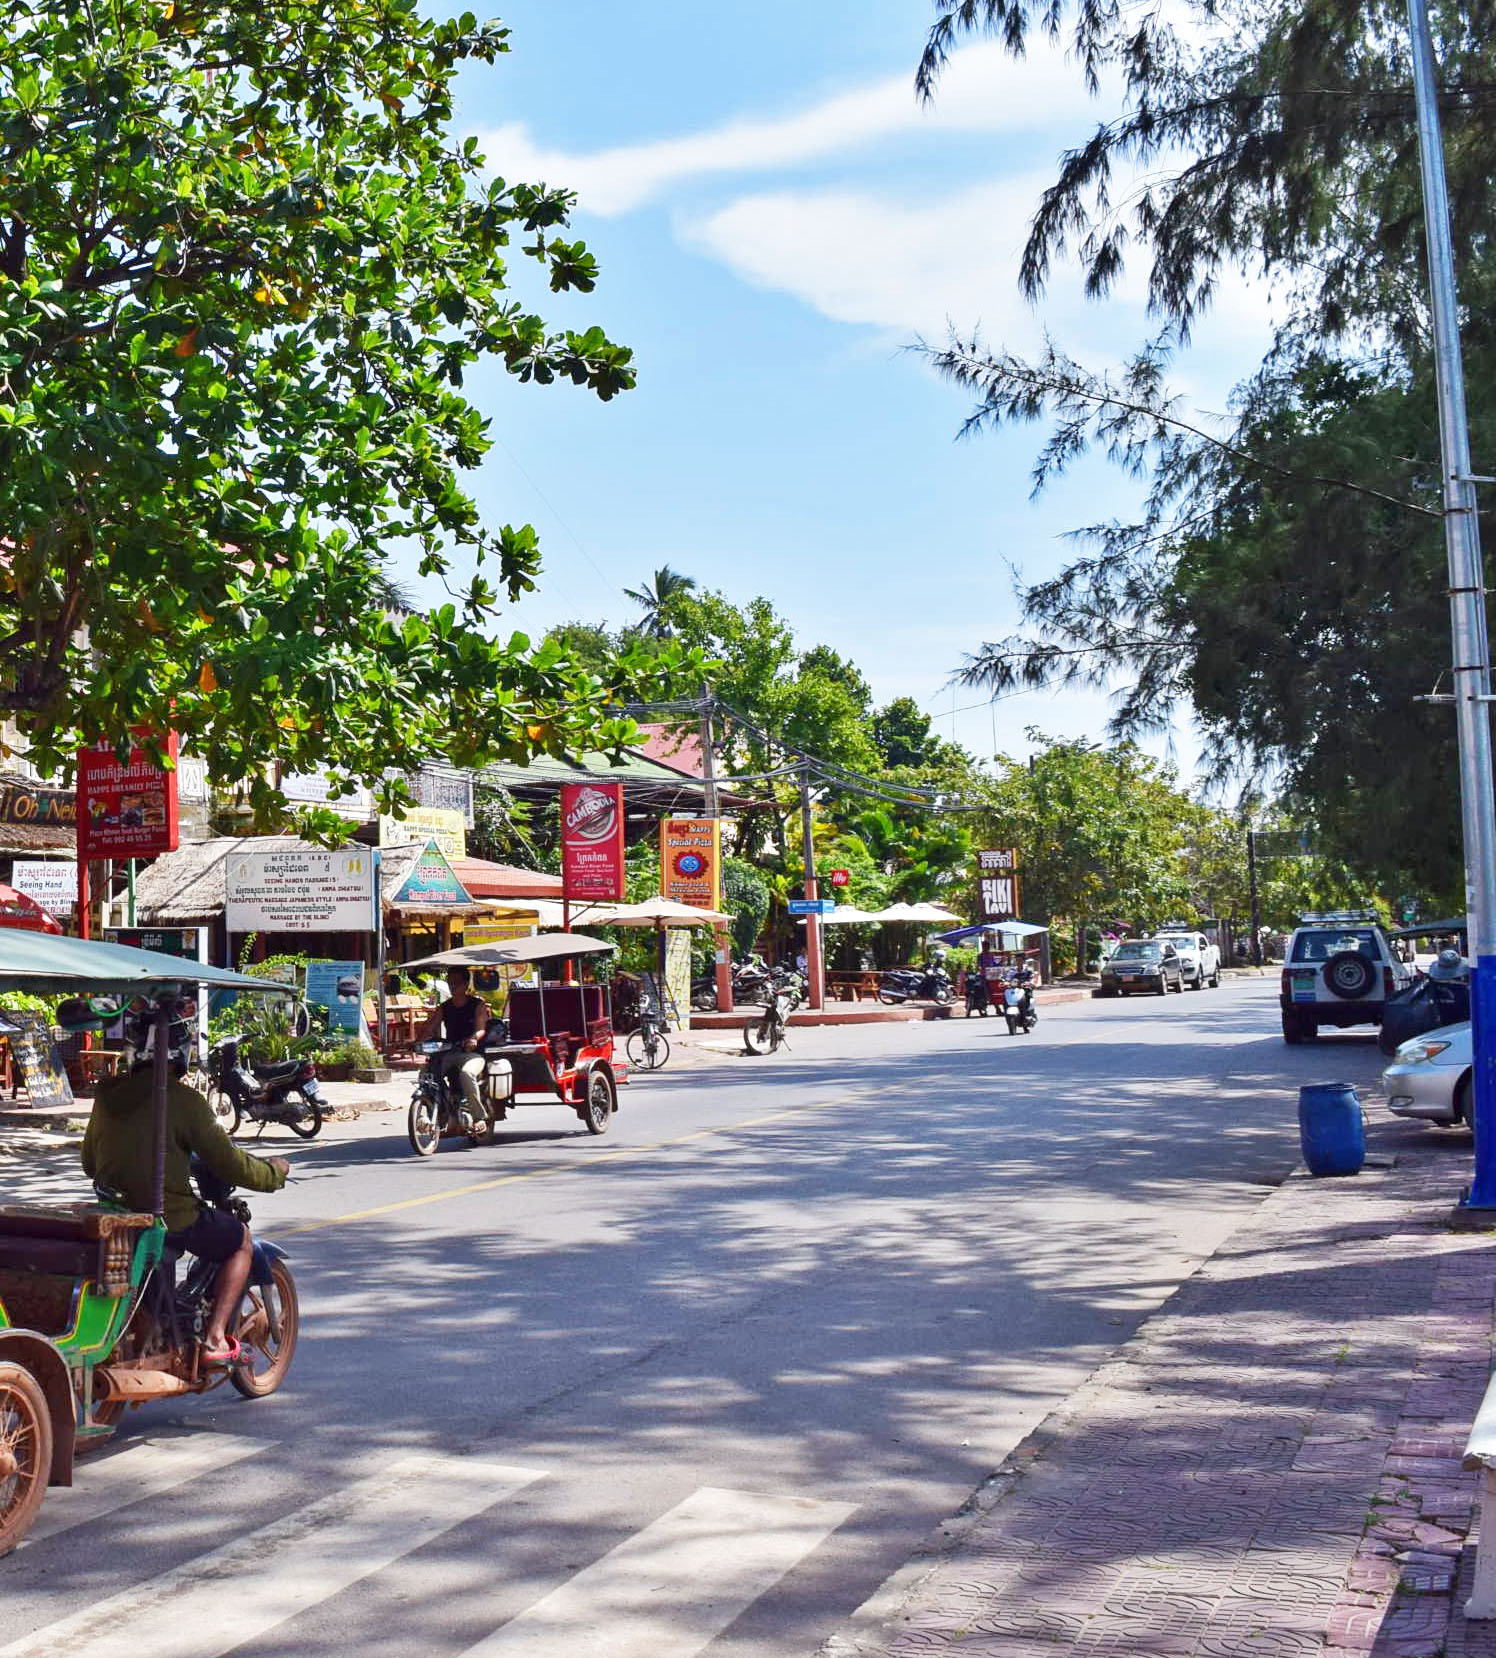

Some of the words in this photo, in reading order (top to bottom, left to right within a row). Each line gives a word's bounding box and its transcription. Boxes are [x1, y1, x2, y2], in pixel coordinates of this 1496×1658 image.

[13, 795, 40, 819] Oh
[47, 798, 77, 820] Nei
[566, 796, 616, 828] CAMBODIA
[19, 881, 43, 891] Seeing
[44, 880, 63, 889] Hand
[832, 872, 847, 885] illy
[983, 879, 1013, 904] RIKI
[983, 892, 1014, 916] TAVI
